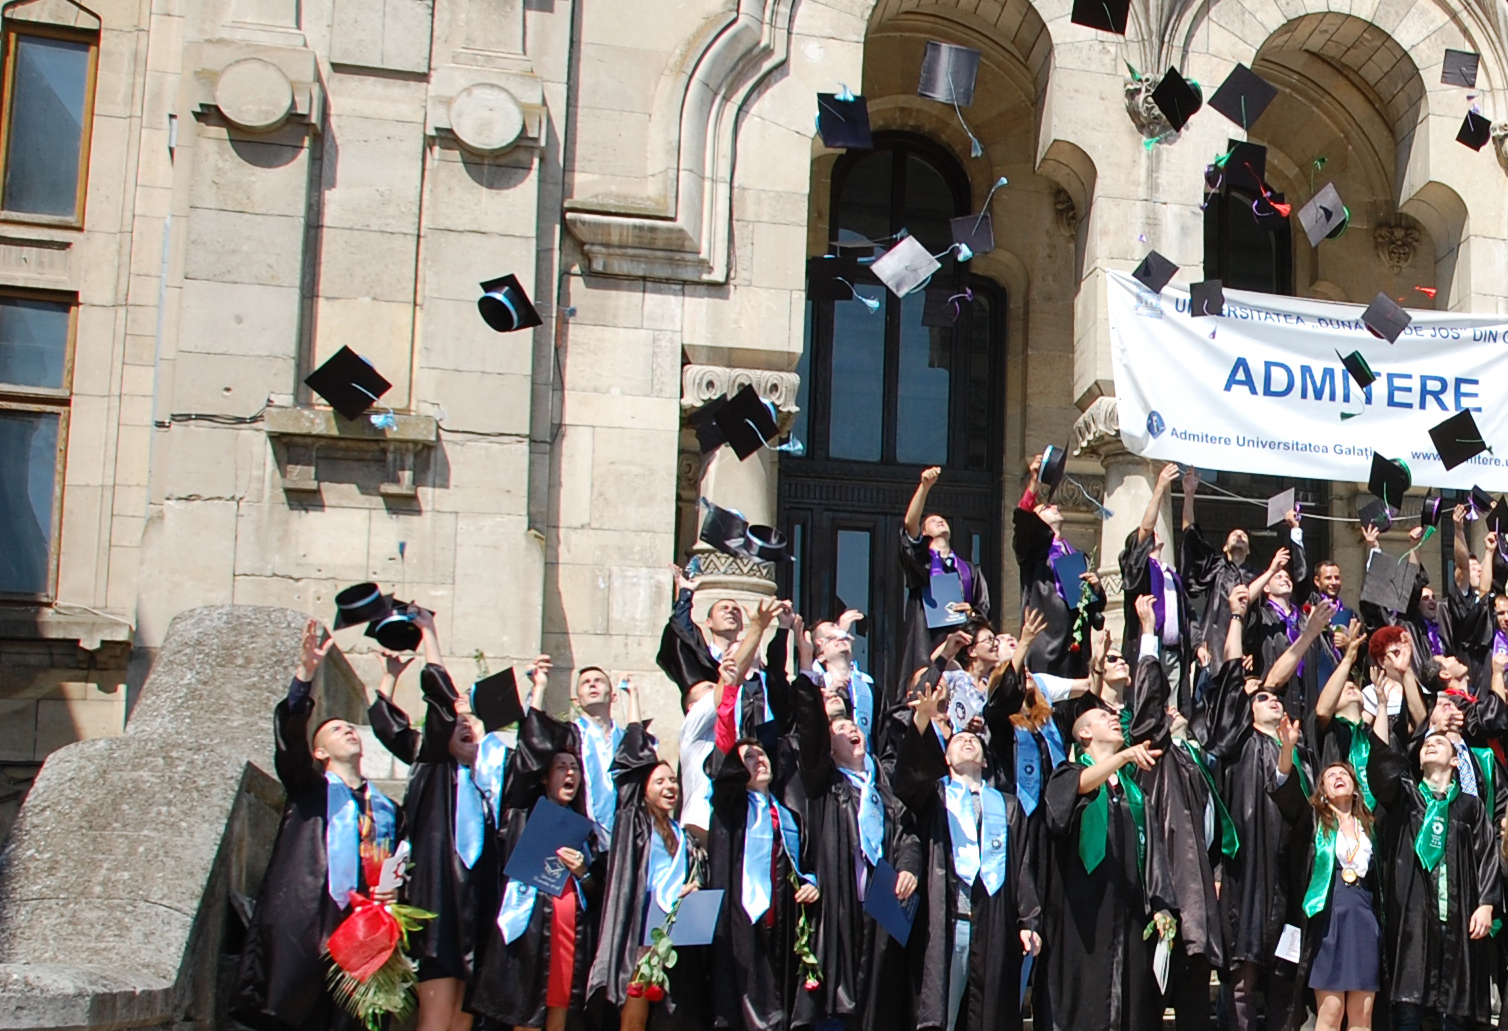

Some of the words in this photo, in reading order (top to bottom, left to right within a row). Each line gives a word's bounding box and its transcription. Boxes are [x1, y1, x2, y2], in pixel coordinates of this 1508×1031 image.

[1473, 328, 1498, 343] DIN
[1171, 427, 1232, 447] Admitere
[1236, 435, 1329, 454] Universitatea
